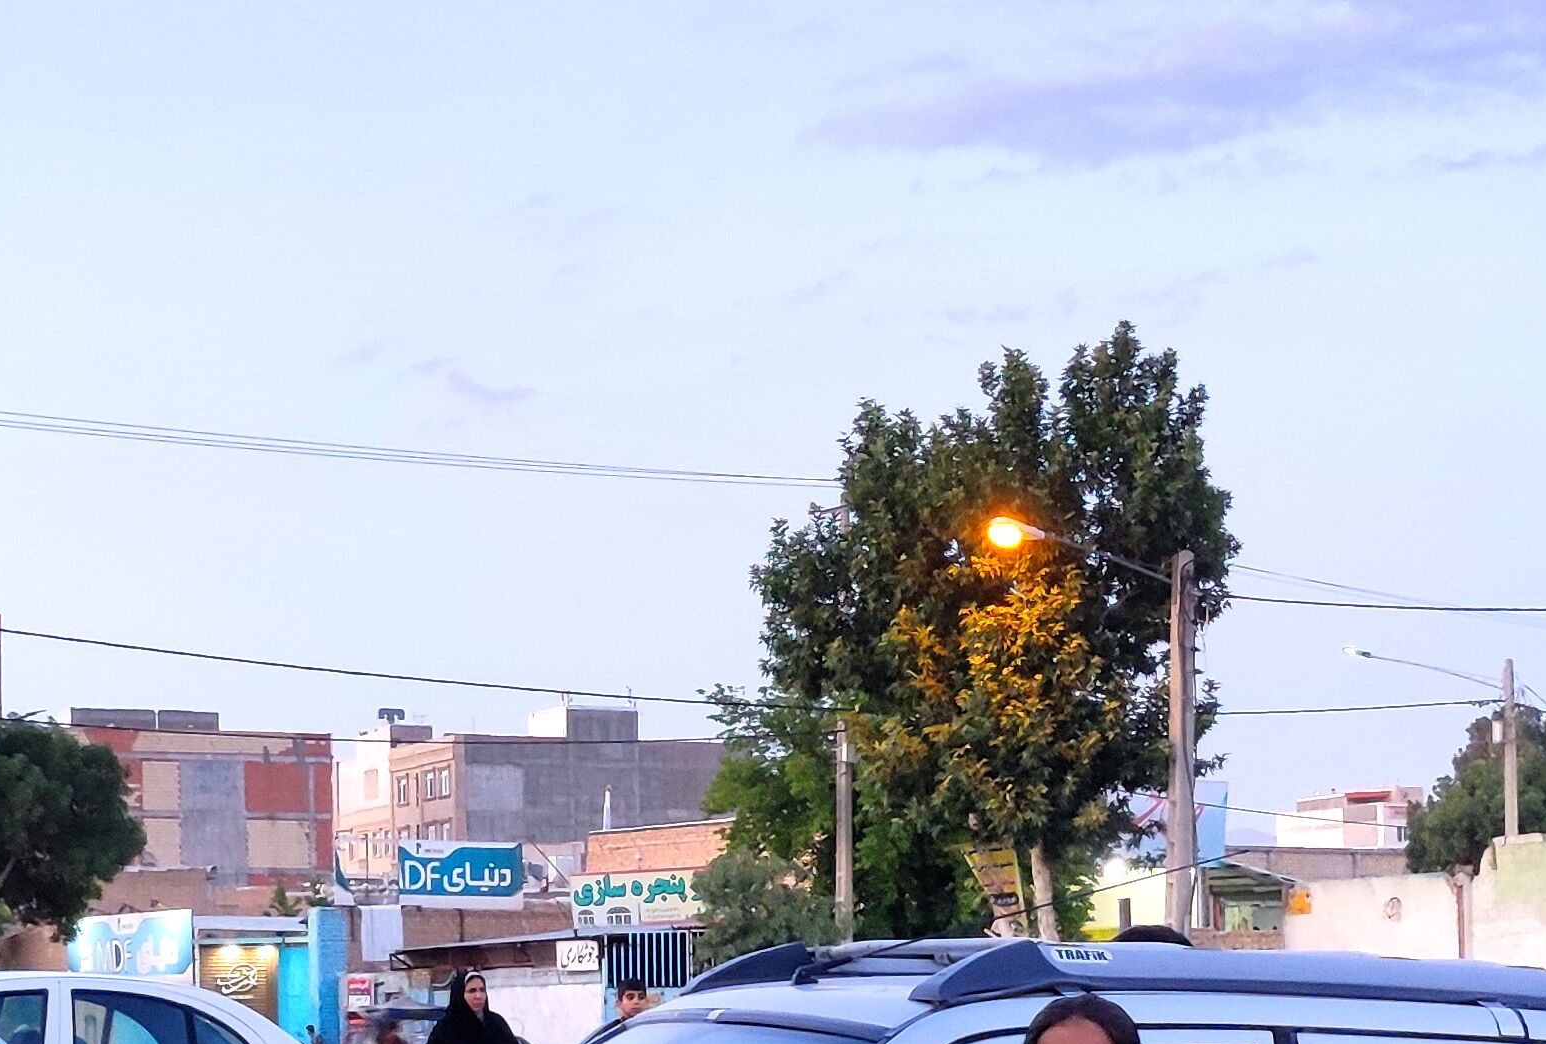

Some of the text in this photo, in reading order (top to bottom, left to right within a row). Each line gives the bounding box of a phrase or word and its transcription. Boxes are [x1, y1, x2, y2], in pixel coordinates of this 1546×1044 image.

[443, 862, 512, 892] دنیای
[573, 873, 688, 906] پنجره سازی
